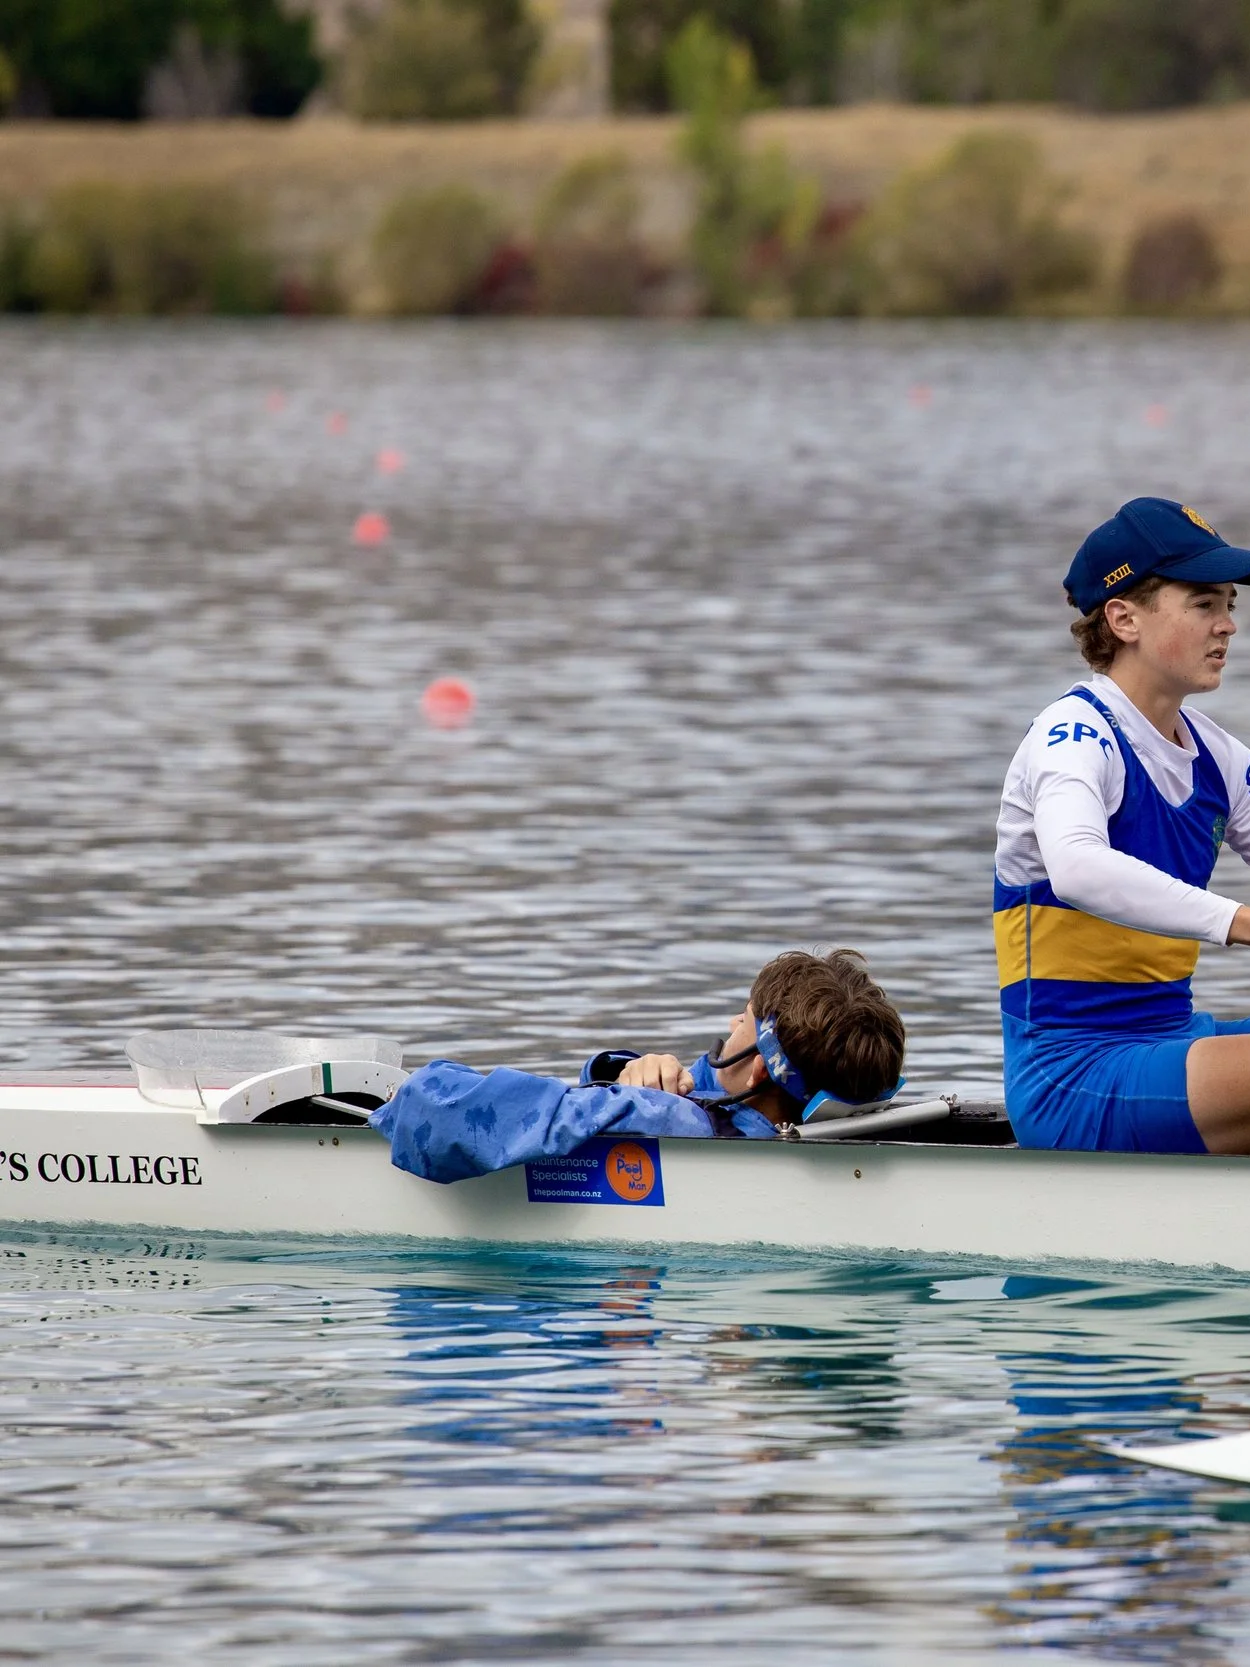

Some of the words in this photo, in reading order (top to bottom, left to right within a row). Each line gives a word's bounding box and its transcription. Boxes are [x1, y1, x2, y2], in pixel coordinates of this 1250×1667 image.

[1103, 563, 1134, 588] XXIII
[0, 1150, 29, 1182] 'S
[37, 1152, 202, 1185] COLLEGE
[532, 1170, 588, 1182] Specialists
[616, 1158, 643, 1181] Pool
[533, 1188, 602, 1198] thepoolman.co.nz
[628, 1181, 647, 1191] Man
